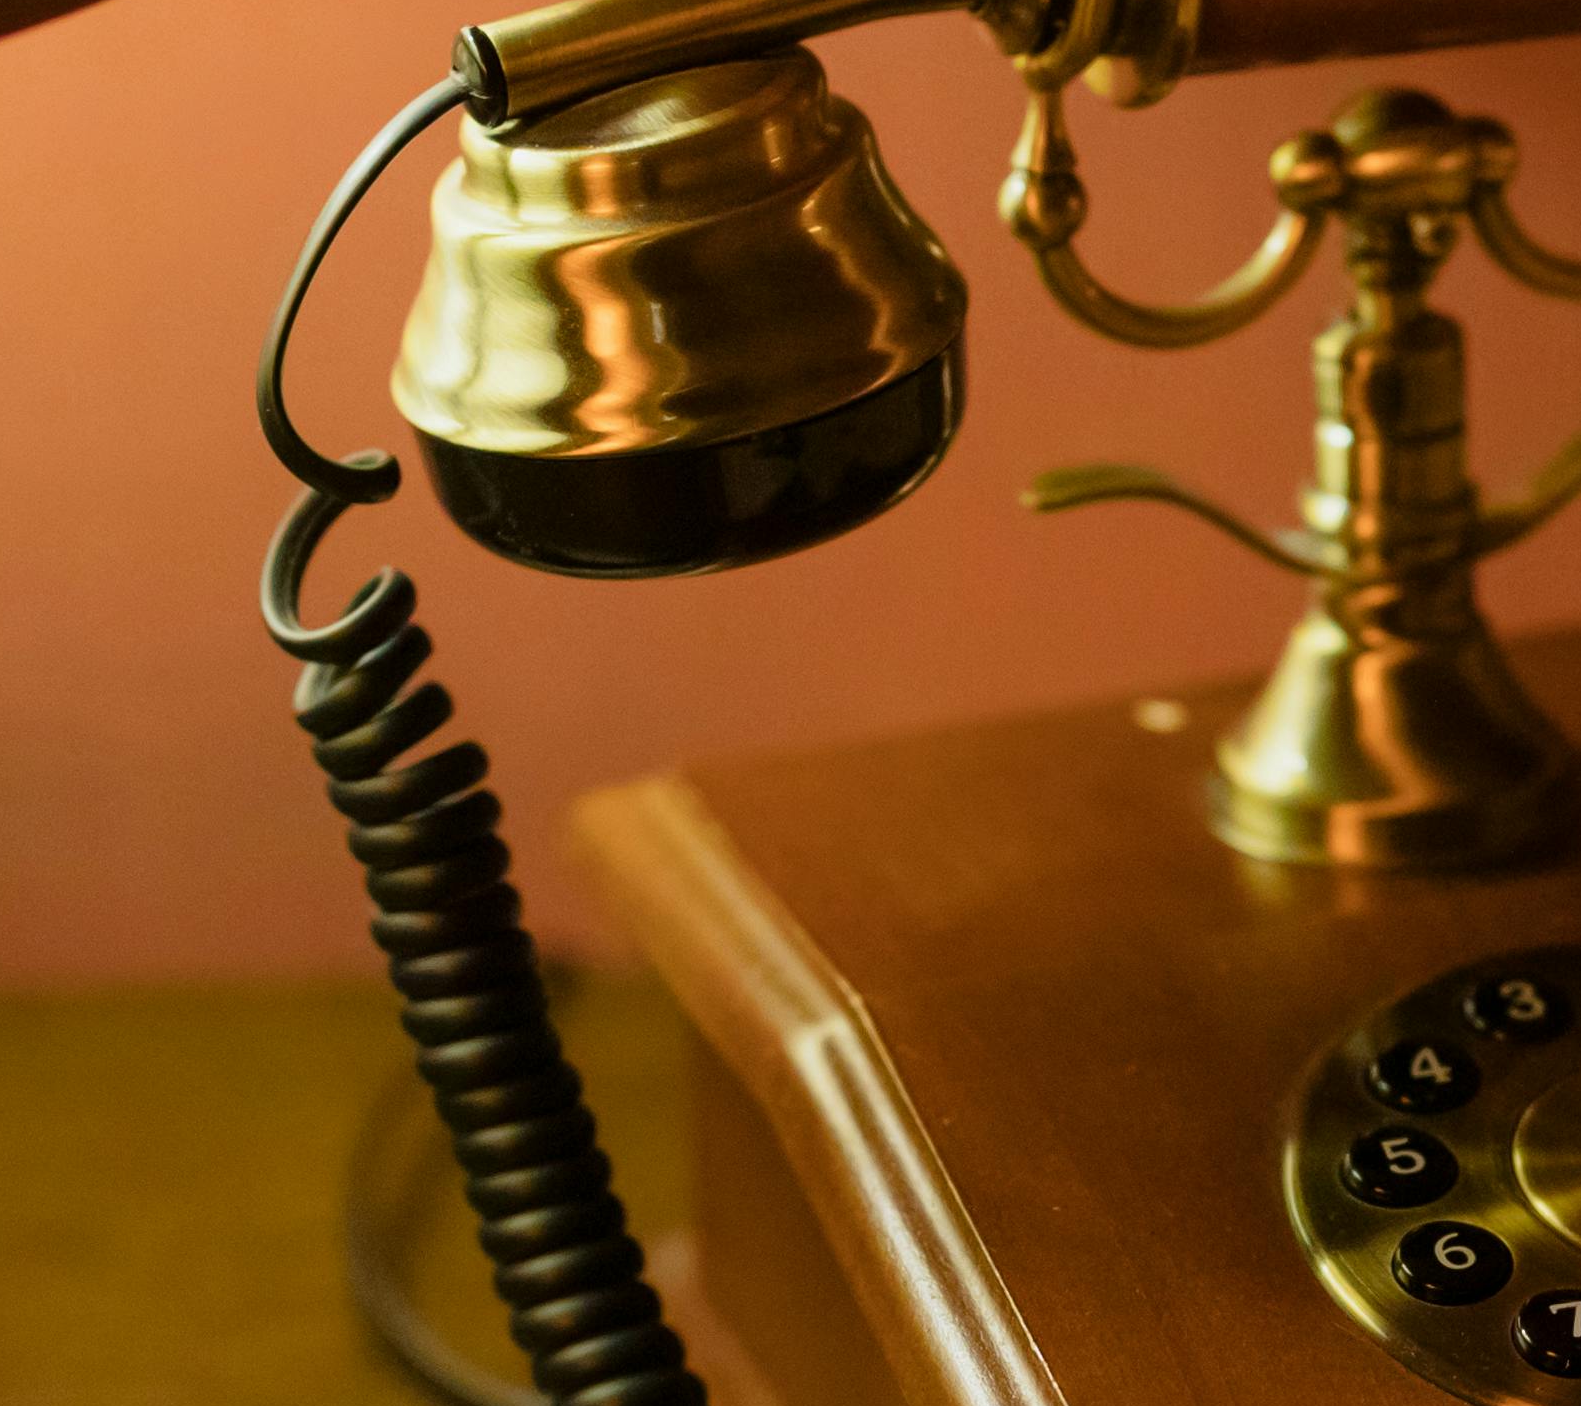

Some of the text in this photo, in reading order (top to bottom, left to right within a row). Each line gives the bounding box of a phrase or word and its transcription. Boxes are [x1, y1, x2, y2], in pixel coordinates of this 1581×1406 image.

[1500, 981, 1546, 1021] 3
[1410, 1047, 1452, 1085] 4
[1380, 1136, 1427, 1176] 5
[1432, 1231, 1478, 1271] 6
